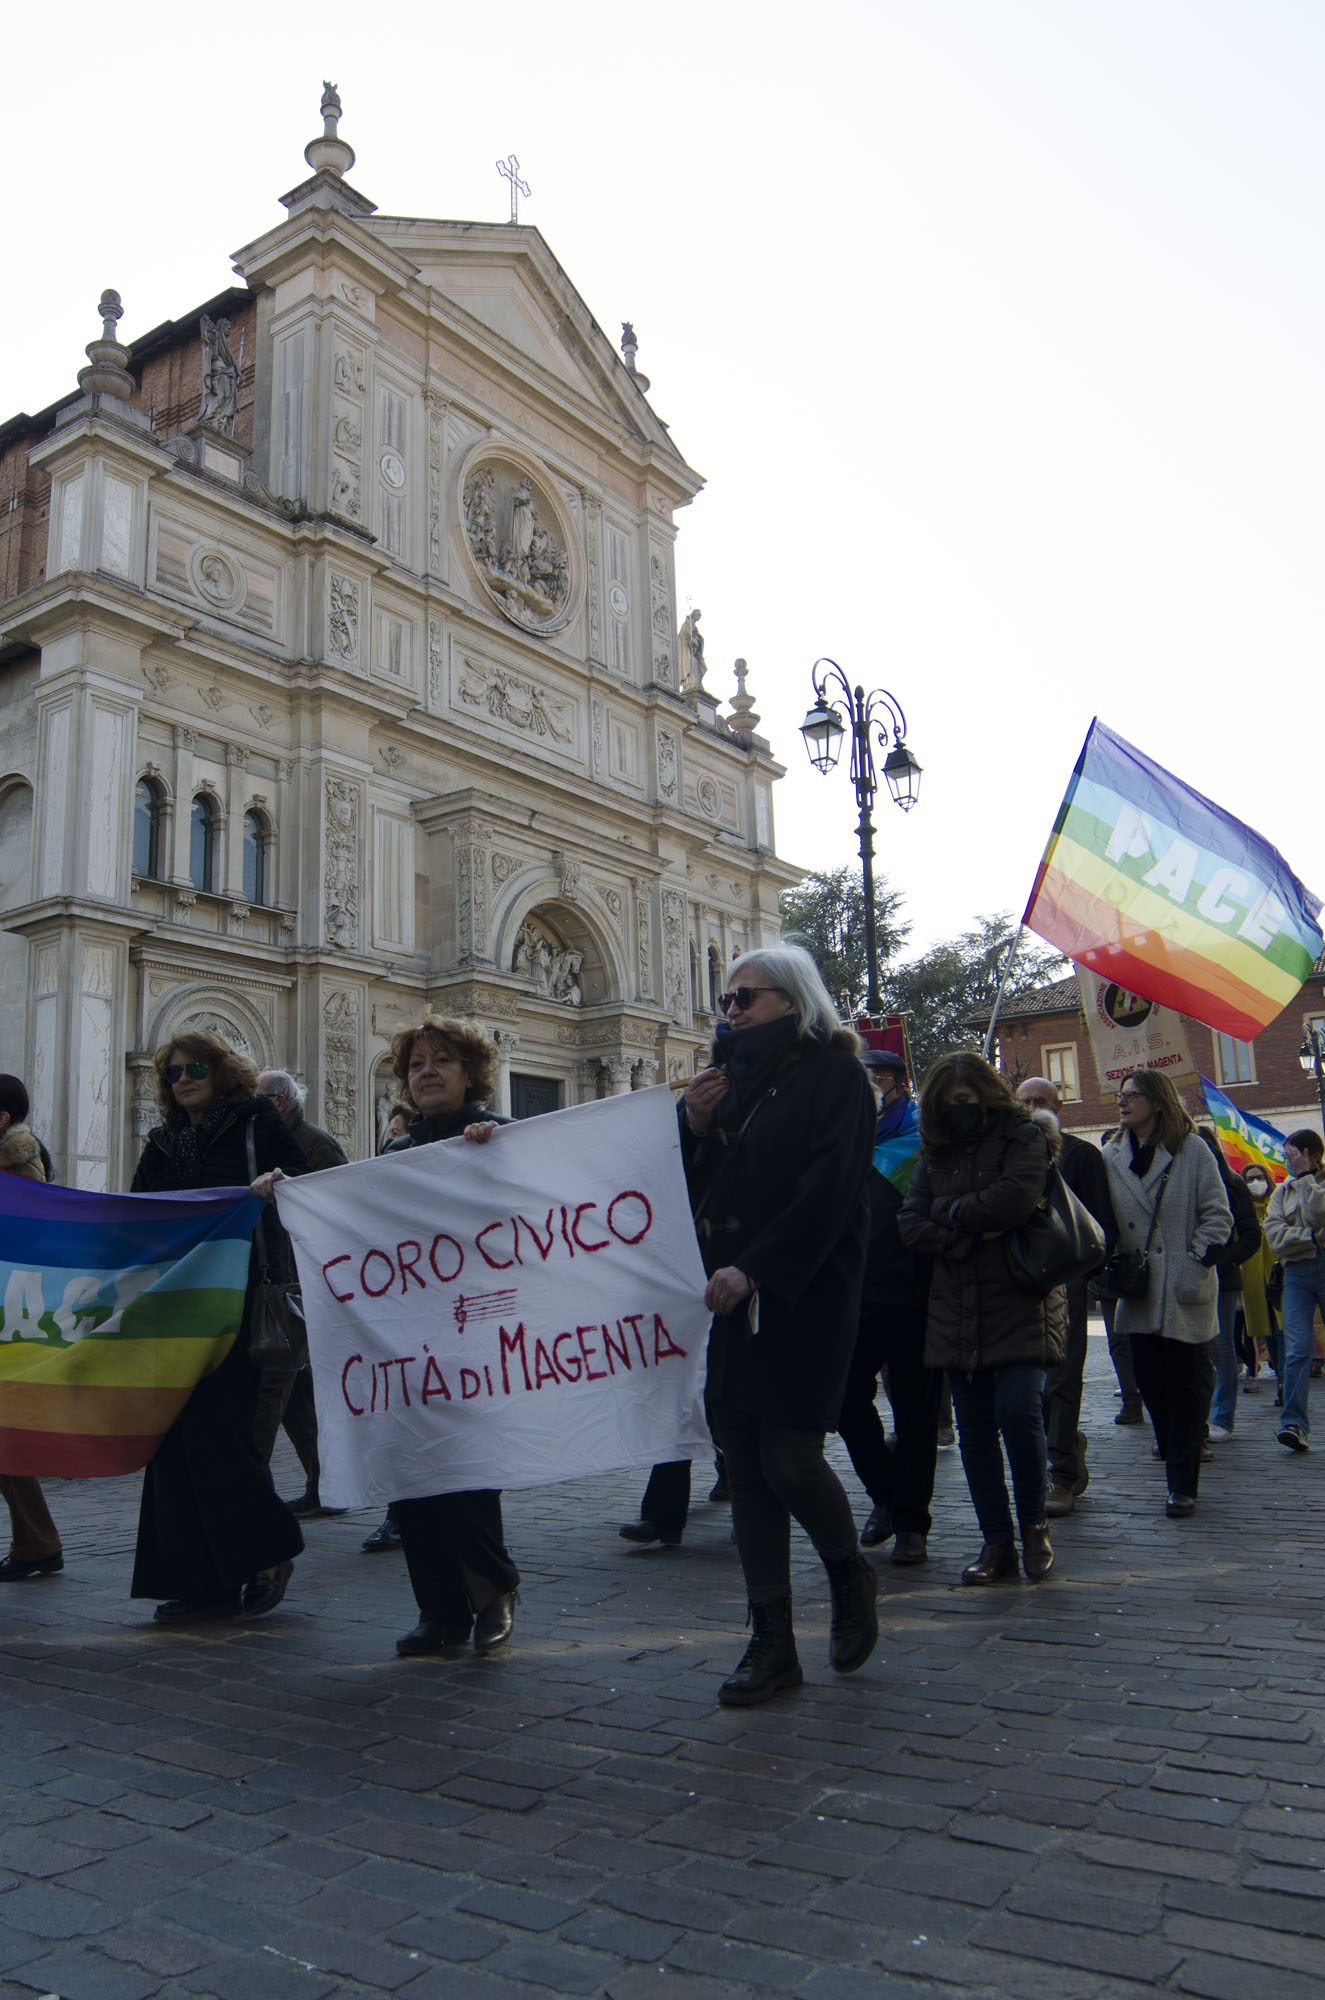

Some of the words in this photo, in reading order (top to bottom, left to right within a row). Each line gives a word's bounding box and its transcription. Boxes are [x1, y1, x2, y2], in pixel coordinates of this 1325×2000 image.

[1105, 803, 1286, 951] PACE
[1096, 983, 1116, 1030] ASSOCIAZIONE
[1113, 1033, 1170, 1060] A.I.S.
[1147, 1053, 1184, 1070] MAGENTA
[323, 1234, 464, 1302] CORO
[474, 1190, 652, 1269] CIVICO
[342, 1344, 451, 1415] CITTÀ
[461, 1364, 494, 1399] DI
[499, 1312, 689, 1395] MAGENTA
